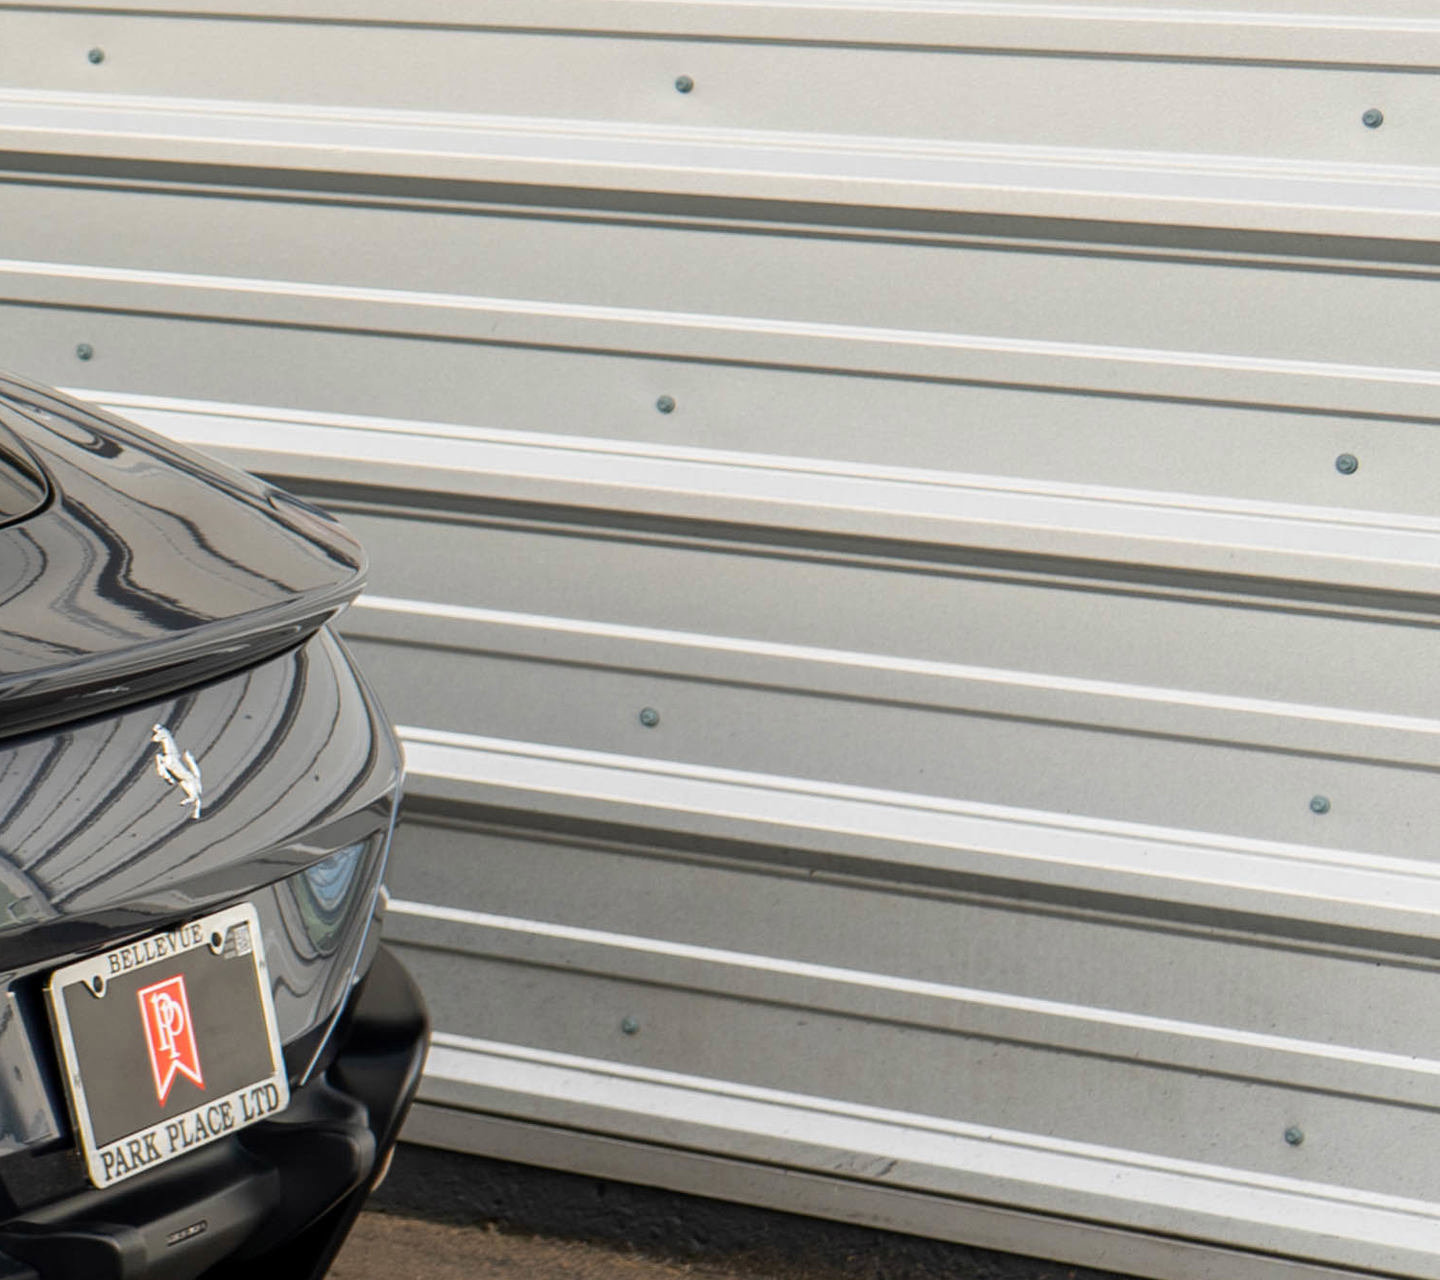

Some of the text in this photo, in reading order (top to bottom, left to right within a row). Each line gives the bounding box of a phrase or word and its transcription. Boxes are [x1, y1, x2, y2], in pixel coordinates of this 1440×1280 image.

[107, 923, 204, 974] BELLEVUE
[100, 1082, 280, 1182] PARK PLACE LTD
